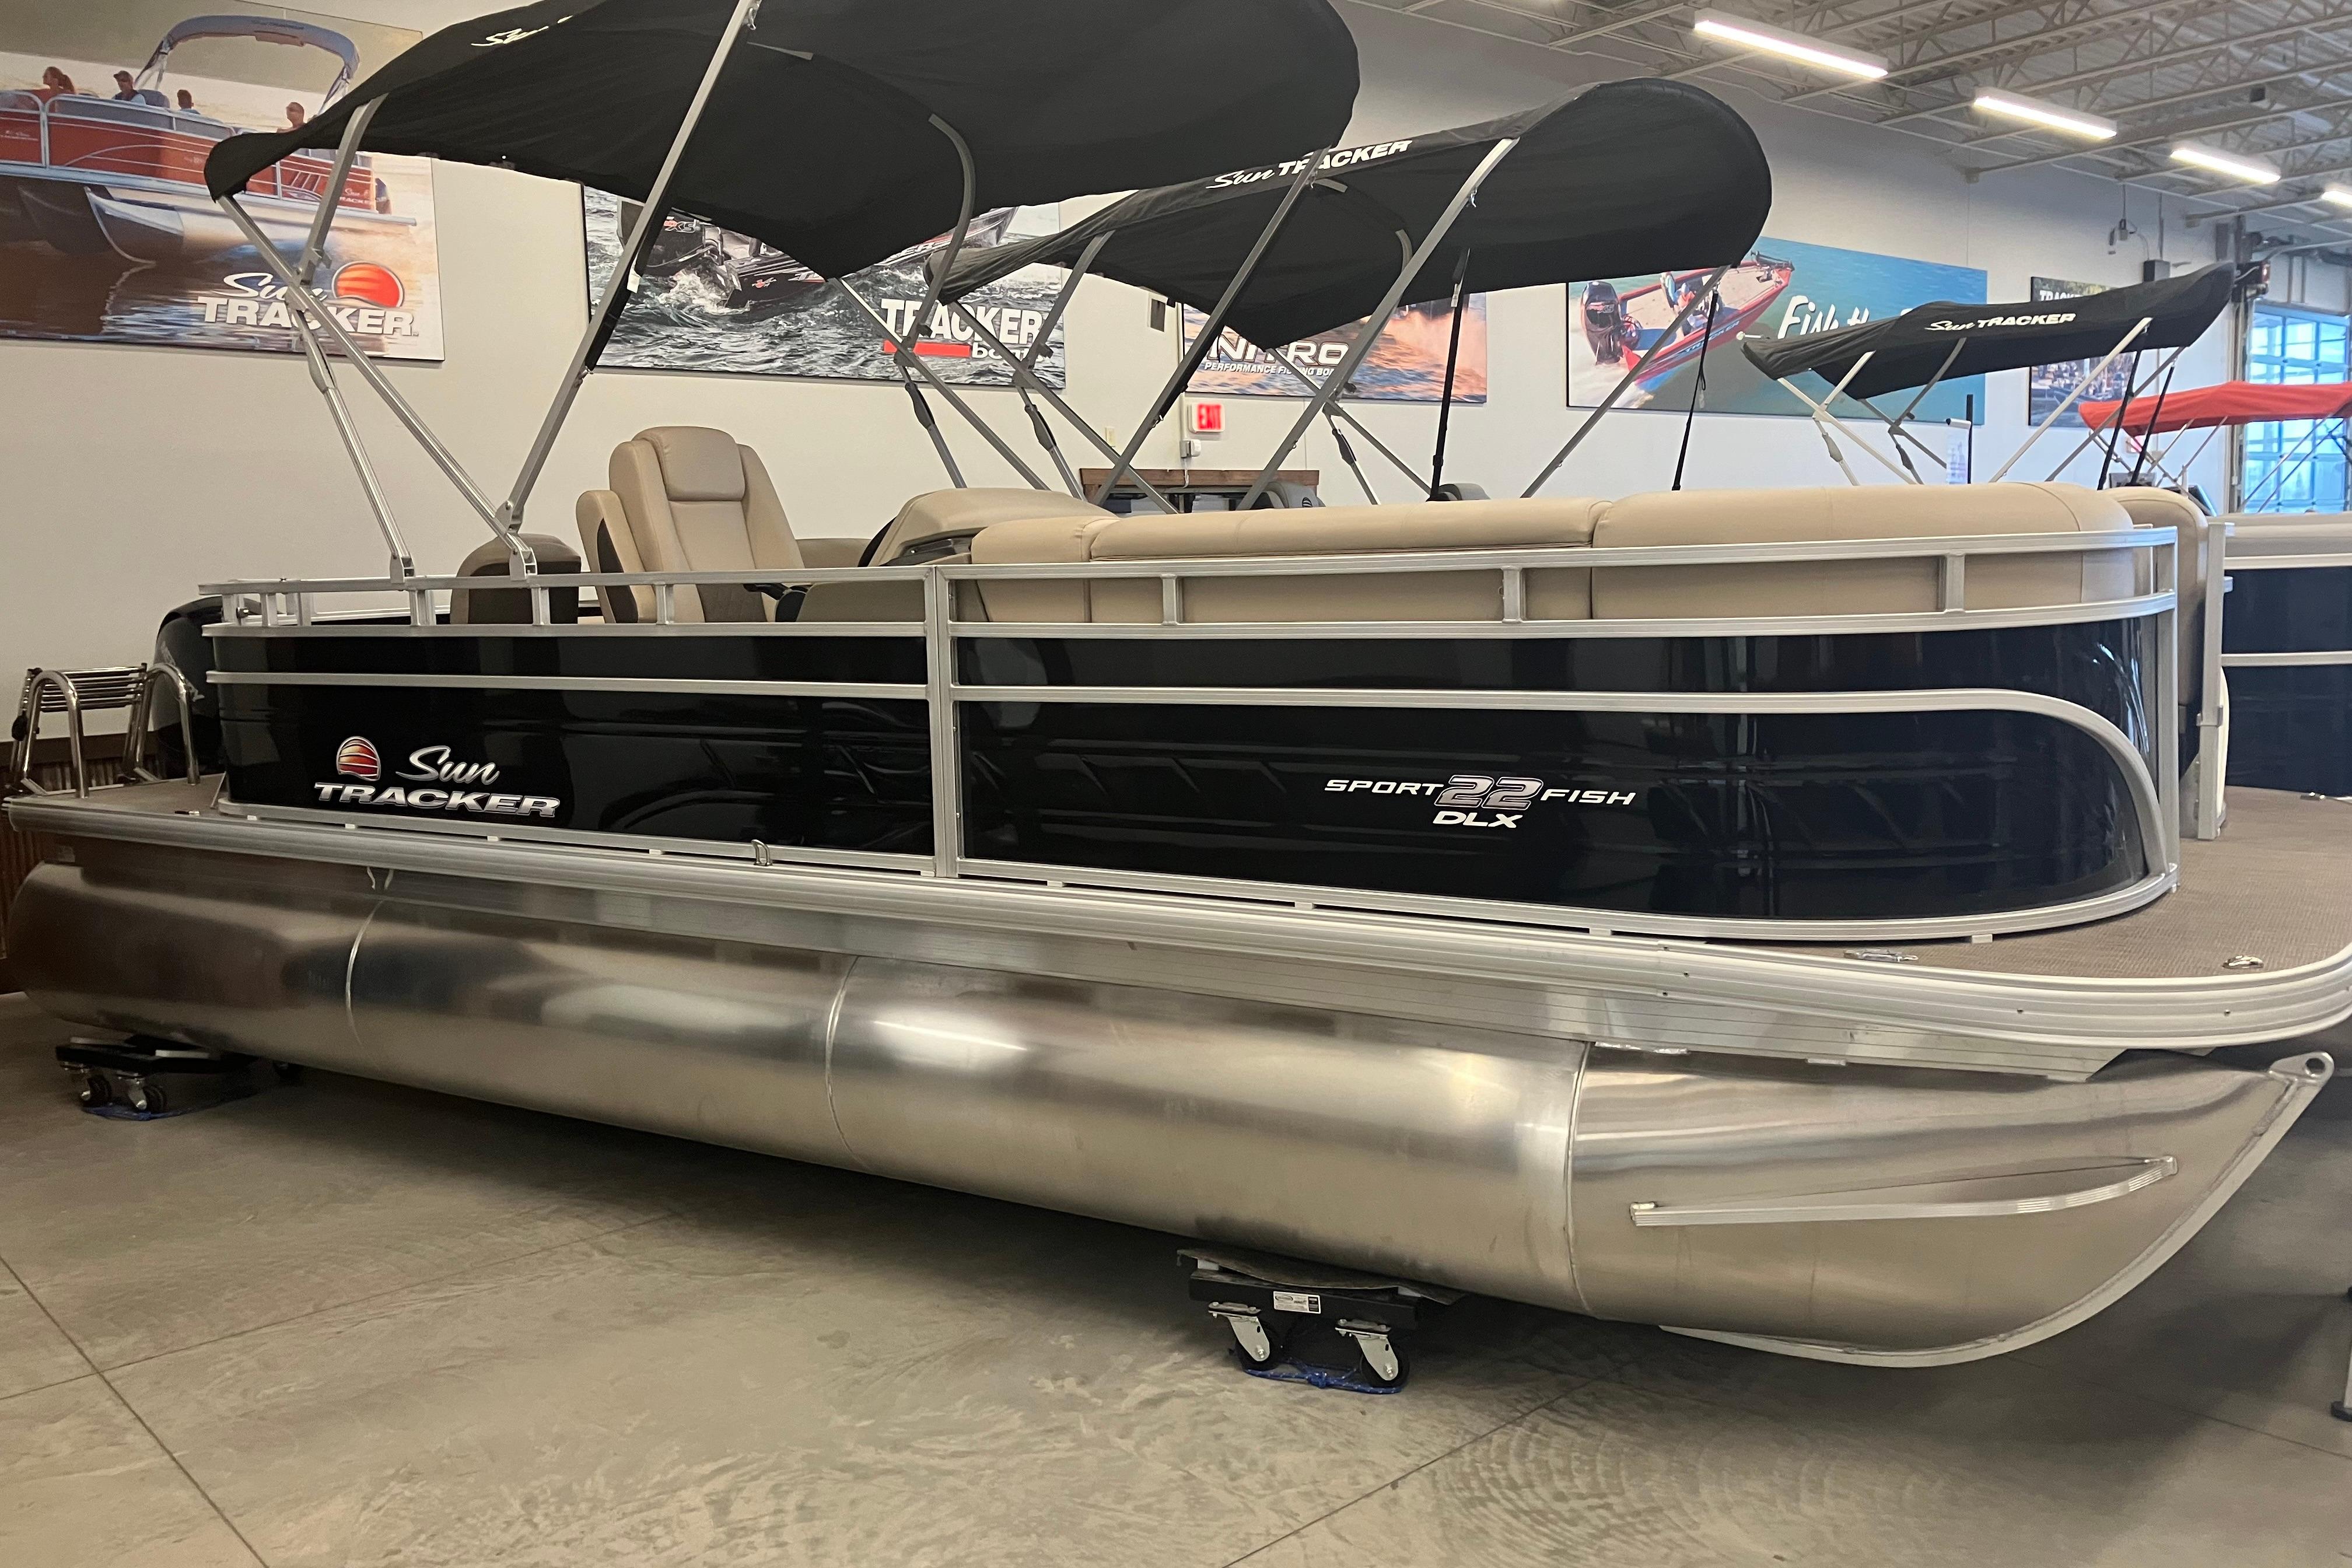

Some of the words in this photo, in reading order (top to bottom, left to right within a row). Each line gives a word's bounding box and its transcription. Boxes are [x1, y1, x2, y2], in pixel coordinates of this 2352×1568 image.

[1205, 169, 1275, 189] Sun
[1924, 320, 1976, 331] Sun
[1976, 313, 2077, 328] TRACKER
[1204, 362, 1276, 374] PERFORMANCE
[1198, 404, 1222, 430] EXIT
[395, 745, 501, 786] Sun
[314, 782, 561, 818] TRACKER
[1324, 779, 1444, 796] SPORT
[1433, 774, 1544, 811] 22
[1540, 789, 1636, 806] FISH
[1432, 810, 1524, 829] DLX
